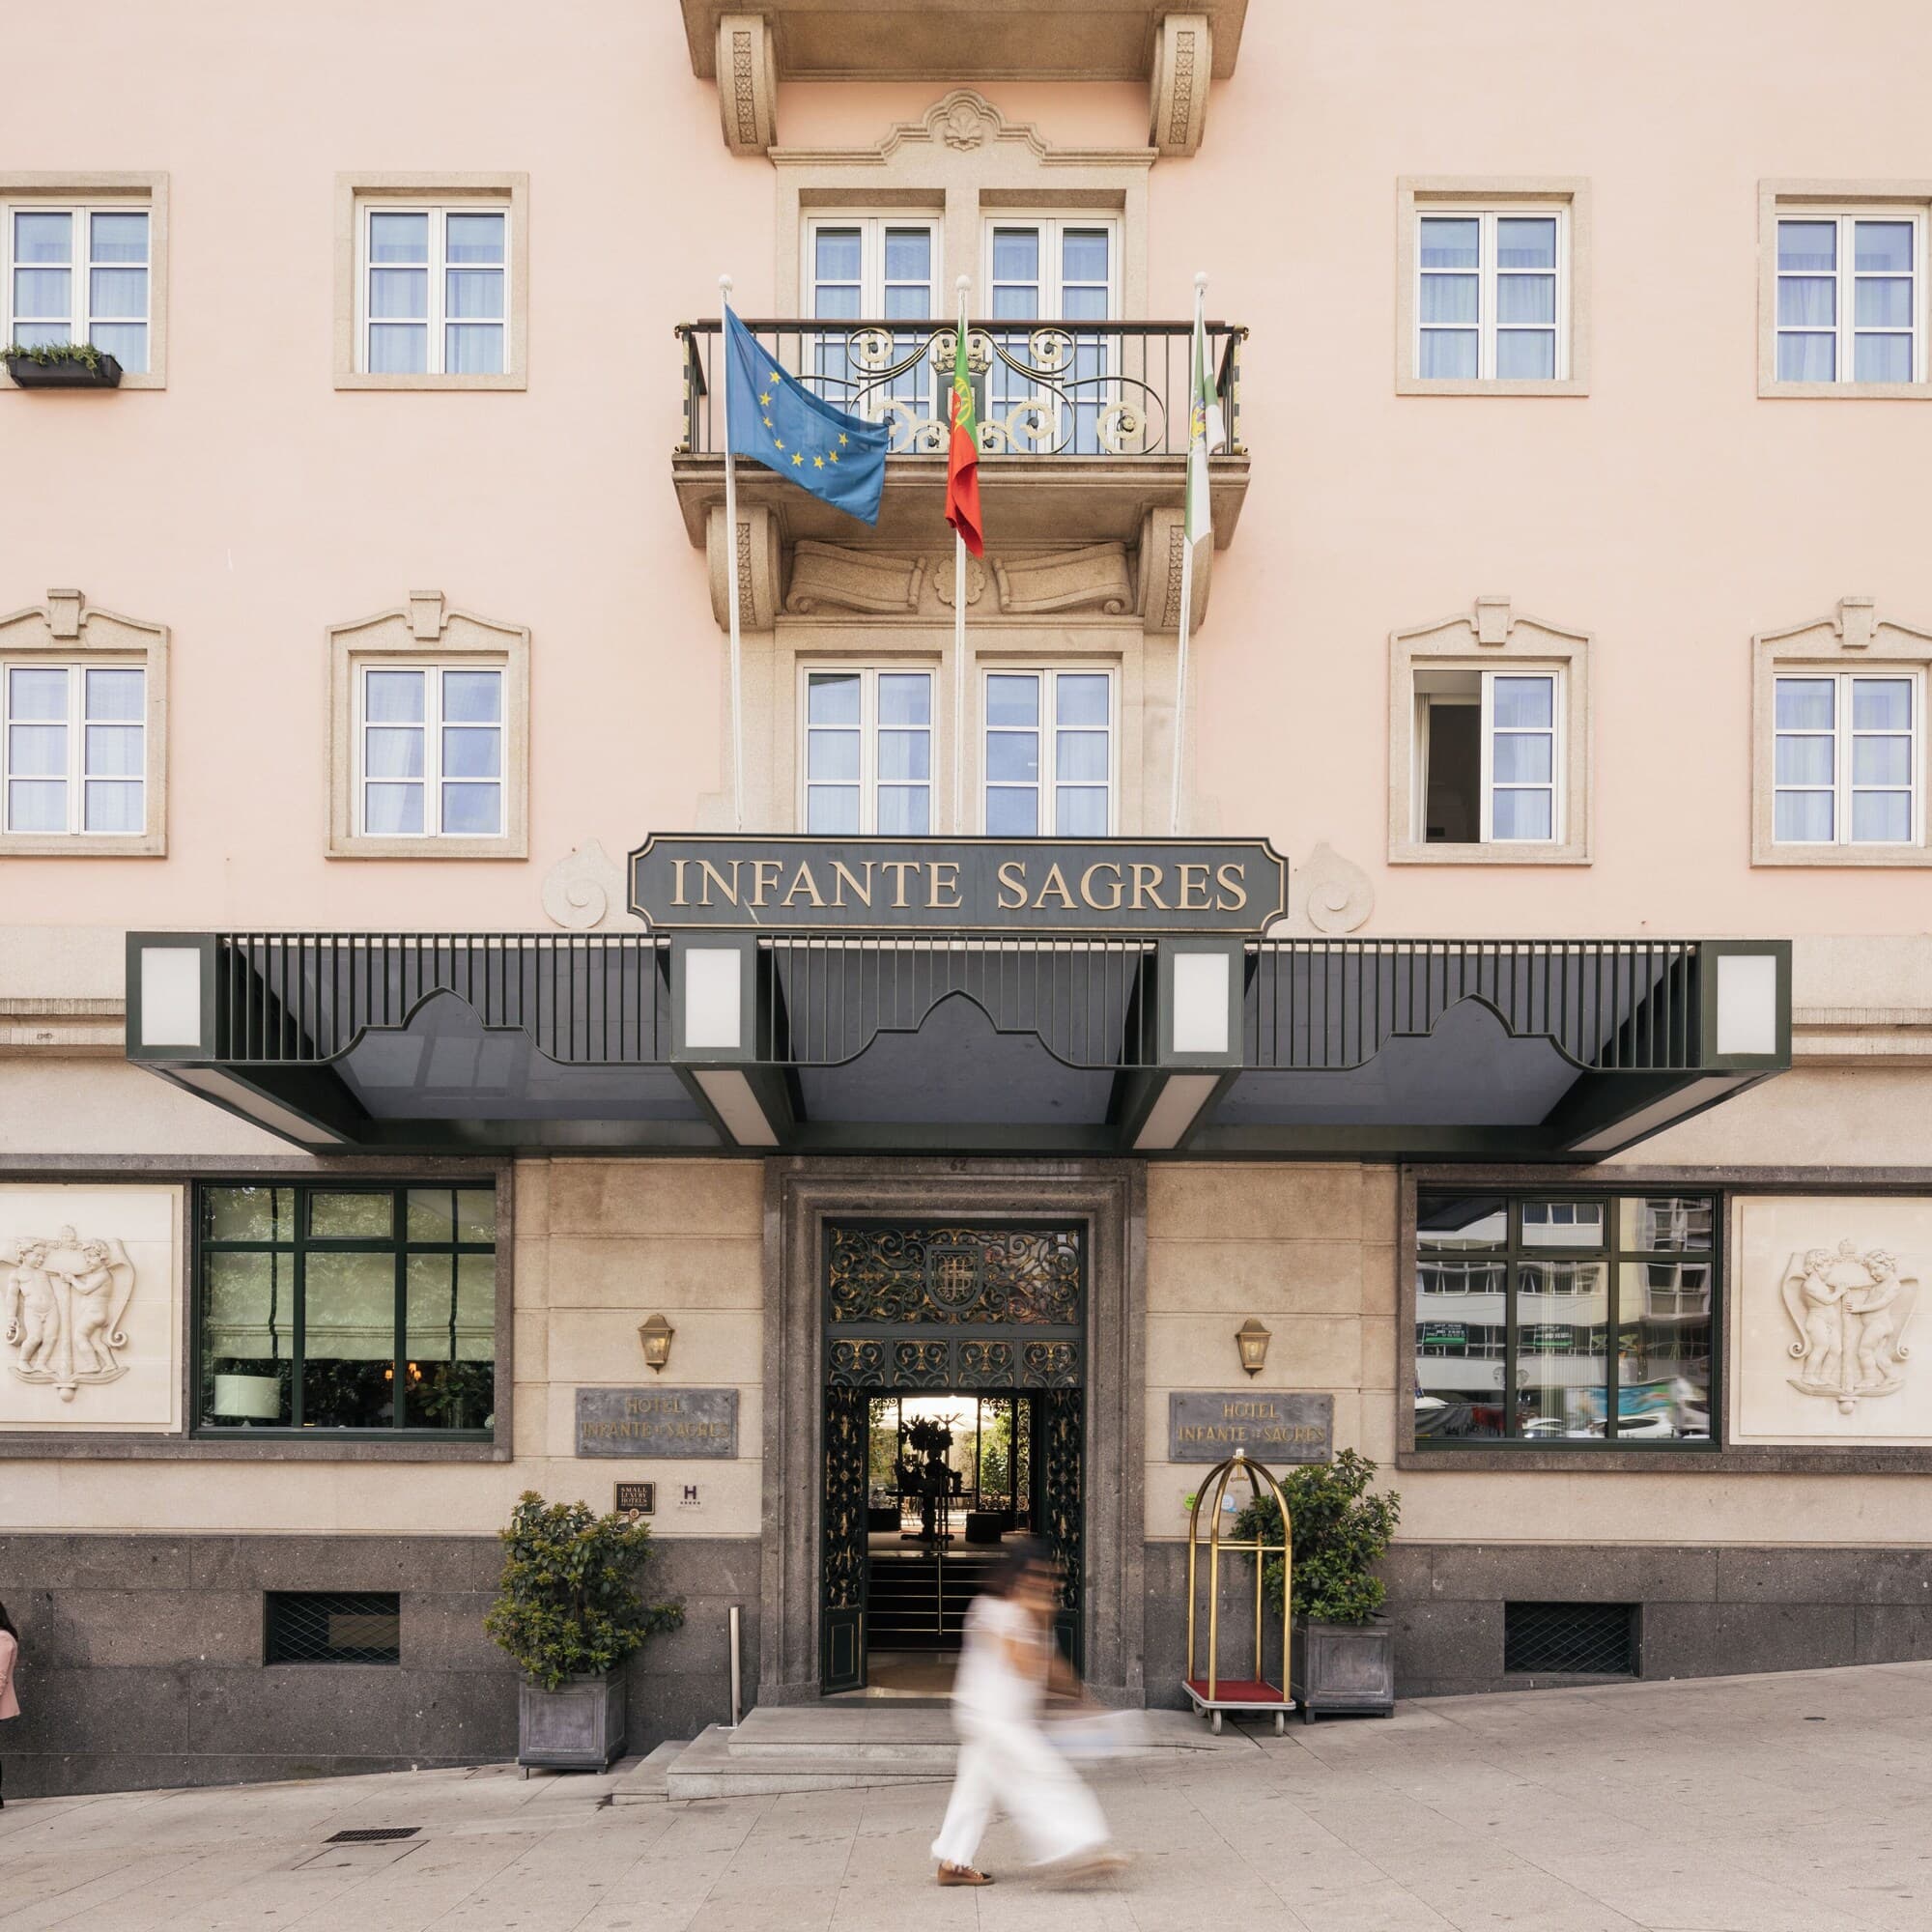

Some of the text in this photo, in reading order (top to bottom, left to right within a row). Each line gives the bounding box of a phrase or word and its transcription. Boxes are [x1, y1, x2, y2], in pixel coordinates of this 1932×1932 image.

[669, 859, 1248, 912] INFANTE SAGRES
[626, 1397, 681, 1413] HOTEL
[1222, 1402, 1279, 1419] HOTEL
[582, 1421, 651, 1438] INFANTE
[1178, 1425, 1248, 1441] INFANTE
[1264, 1425, 1324, 1442] SAGRES
[684, 1485, 696, 1499] H
